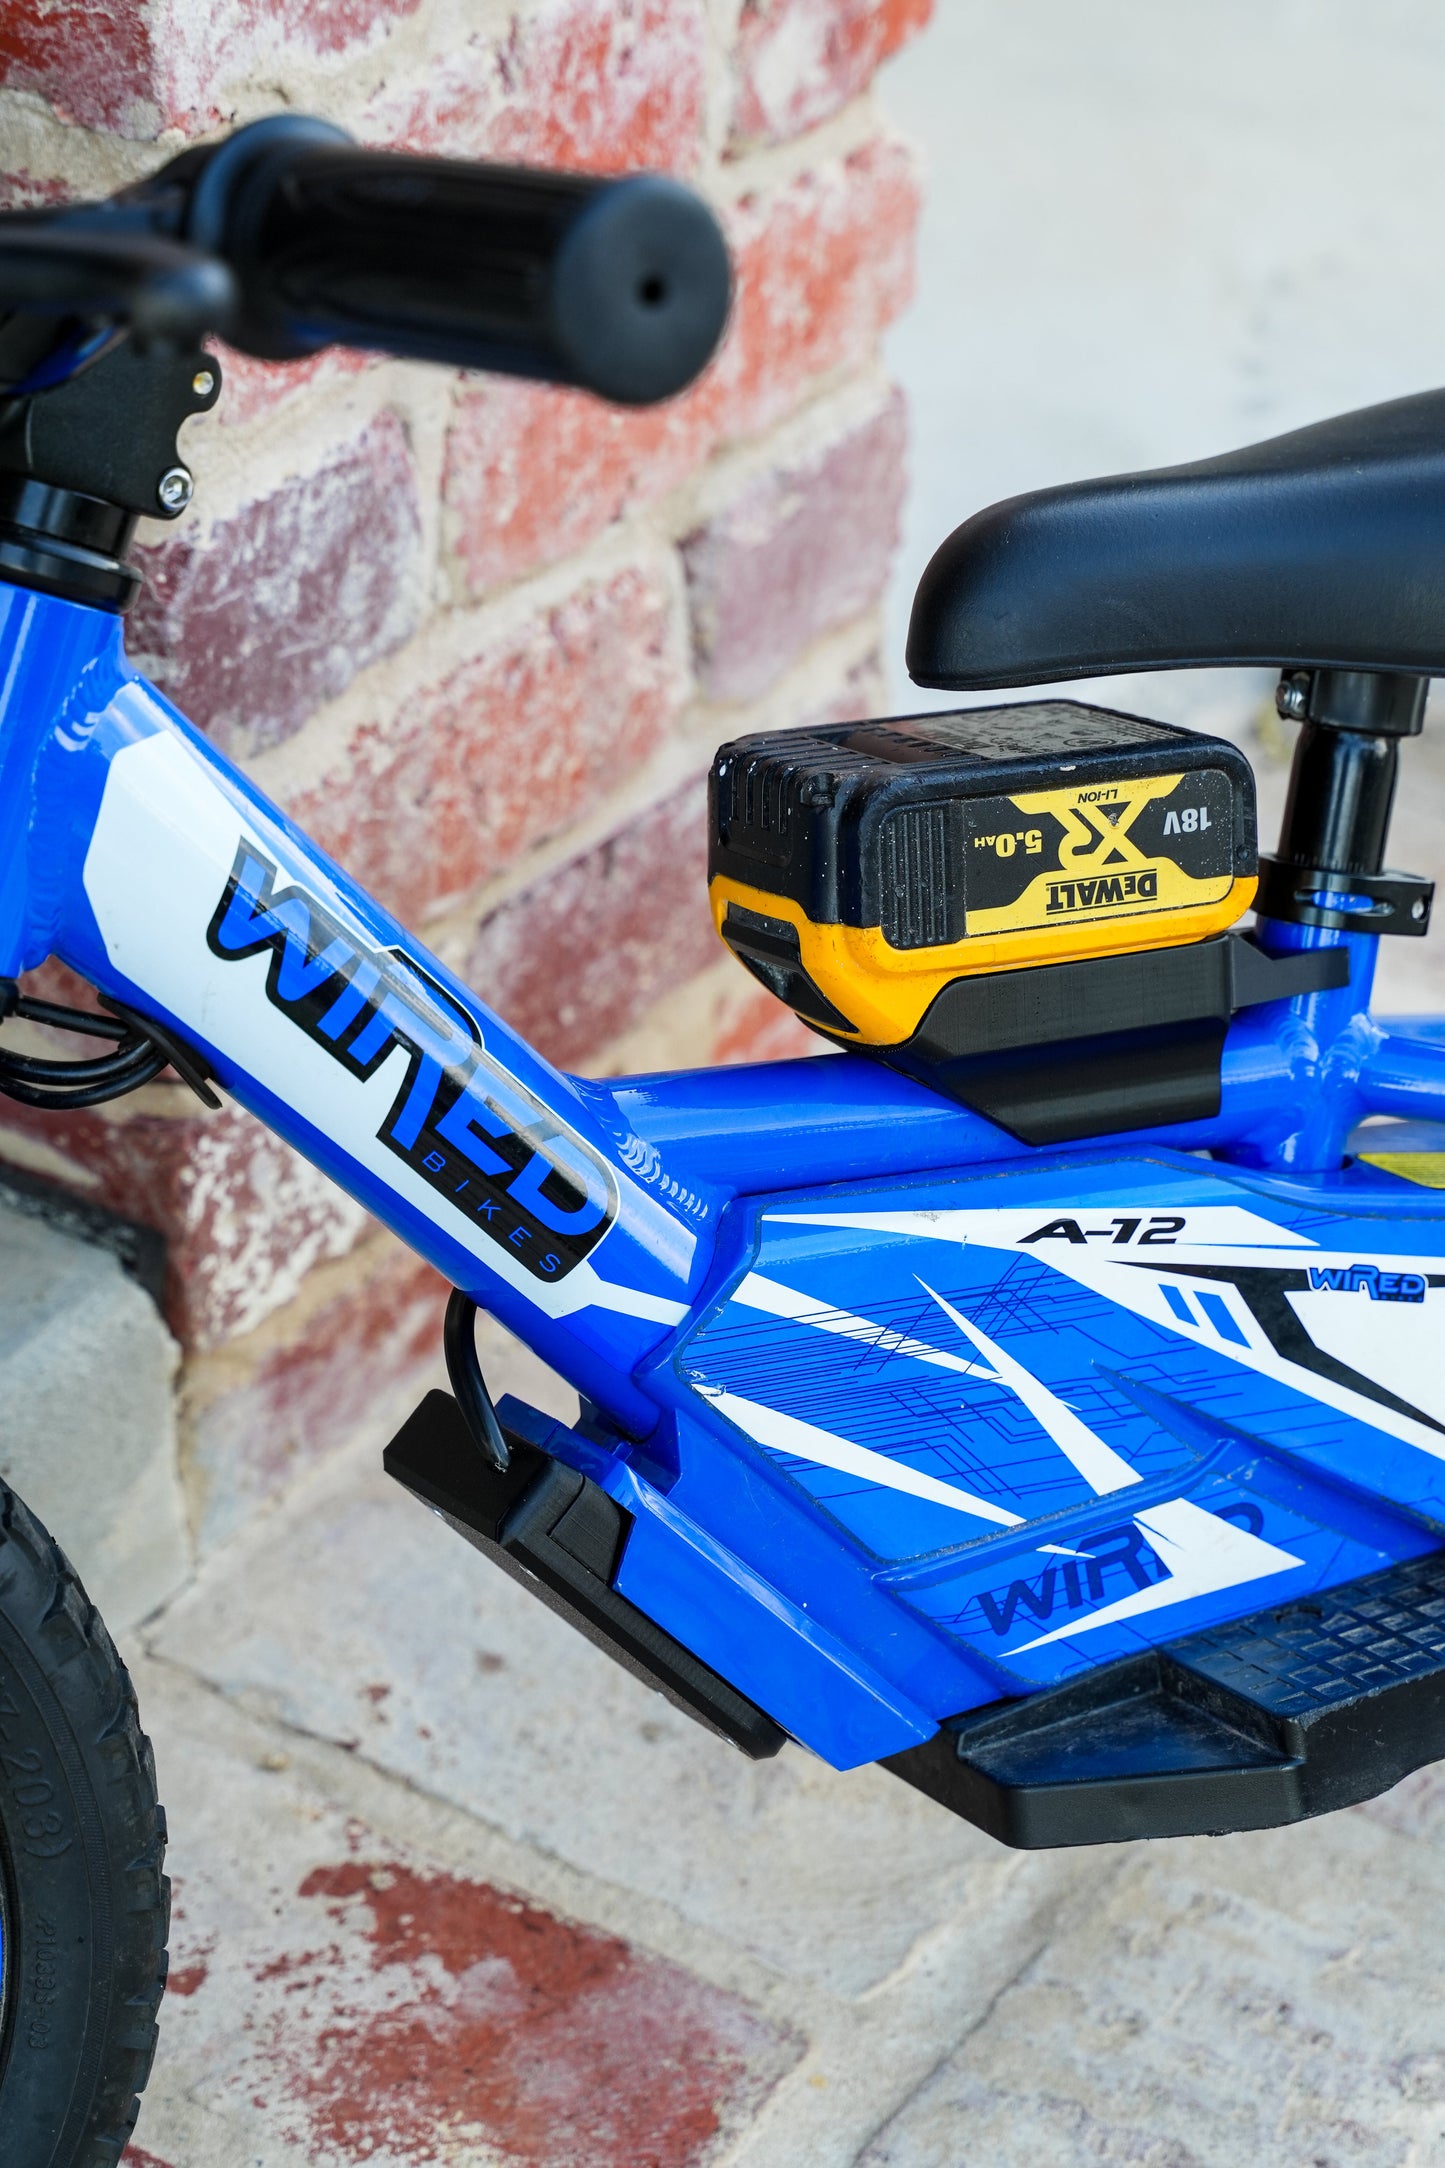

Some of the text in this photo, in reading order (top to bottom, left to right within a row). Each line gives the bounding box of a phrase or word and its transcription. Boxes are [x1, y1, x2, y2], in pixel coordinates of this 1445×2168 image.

[1078, 788, 1118, 804] LI-ION
[1163, 806, 1212, 836] 18V
[213, 846, 614, 1240] WIRED
[421, 1150, 562, 1274] BIKES
[1016, 1216, 1187, 1246] A-12
[1309, 1264, 1426, 1301] WIRED
